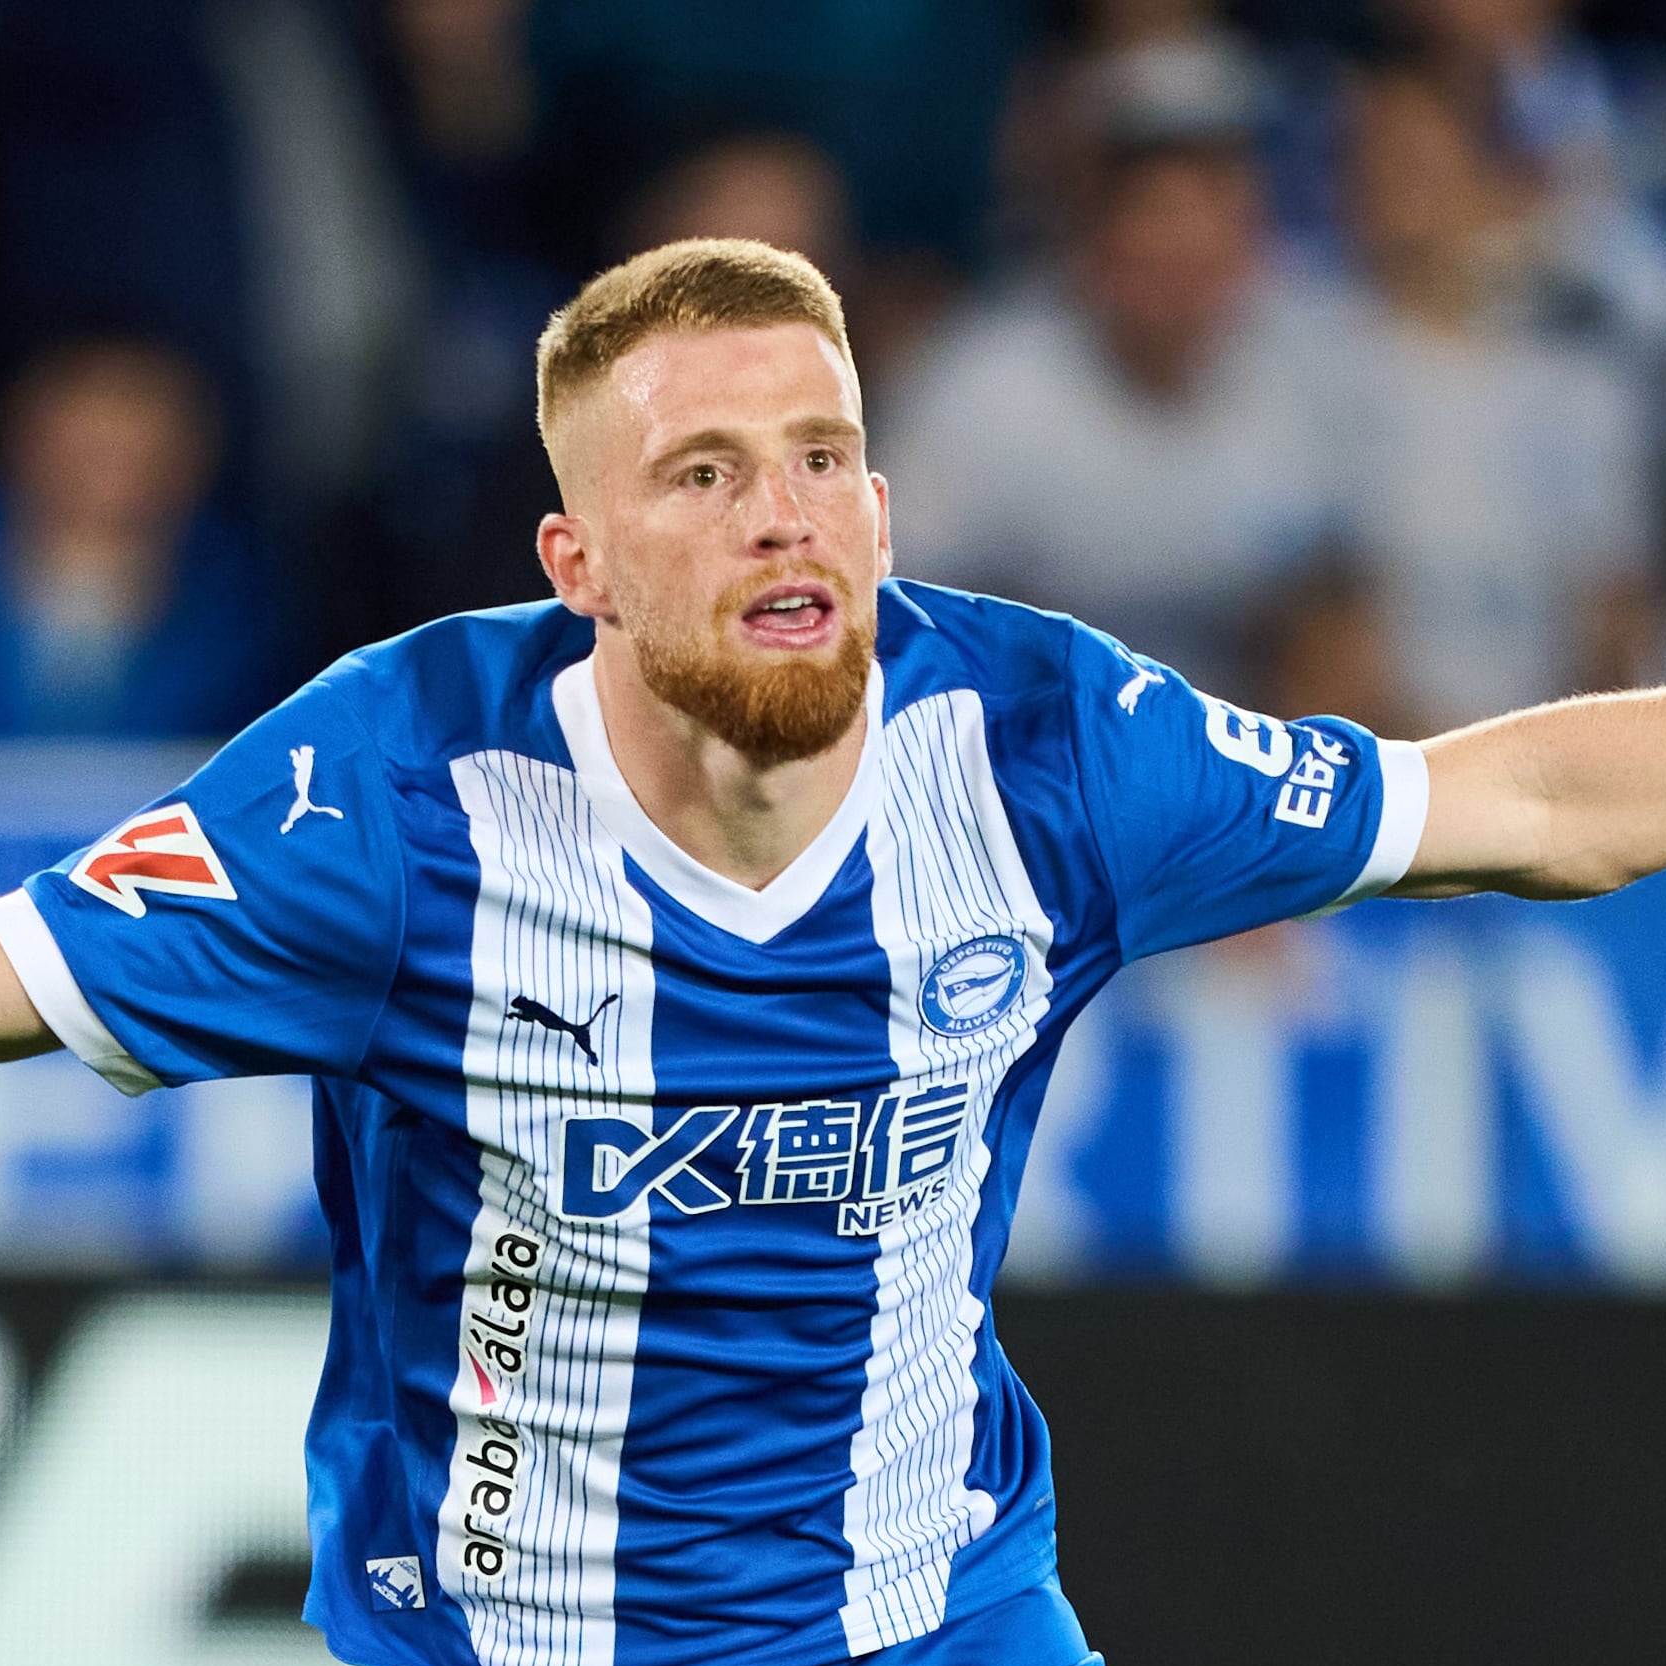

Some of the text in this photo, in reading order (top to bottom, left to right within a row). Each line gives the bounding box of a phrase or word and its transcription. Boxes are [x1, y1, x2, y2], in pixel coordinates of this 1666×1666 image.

[737, 1081, 971, 1206] 德信
[837, 1175, 951, 1237] NEWS
[463, 1414, 521, 1577] araba
